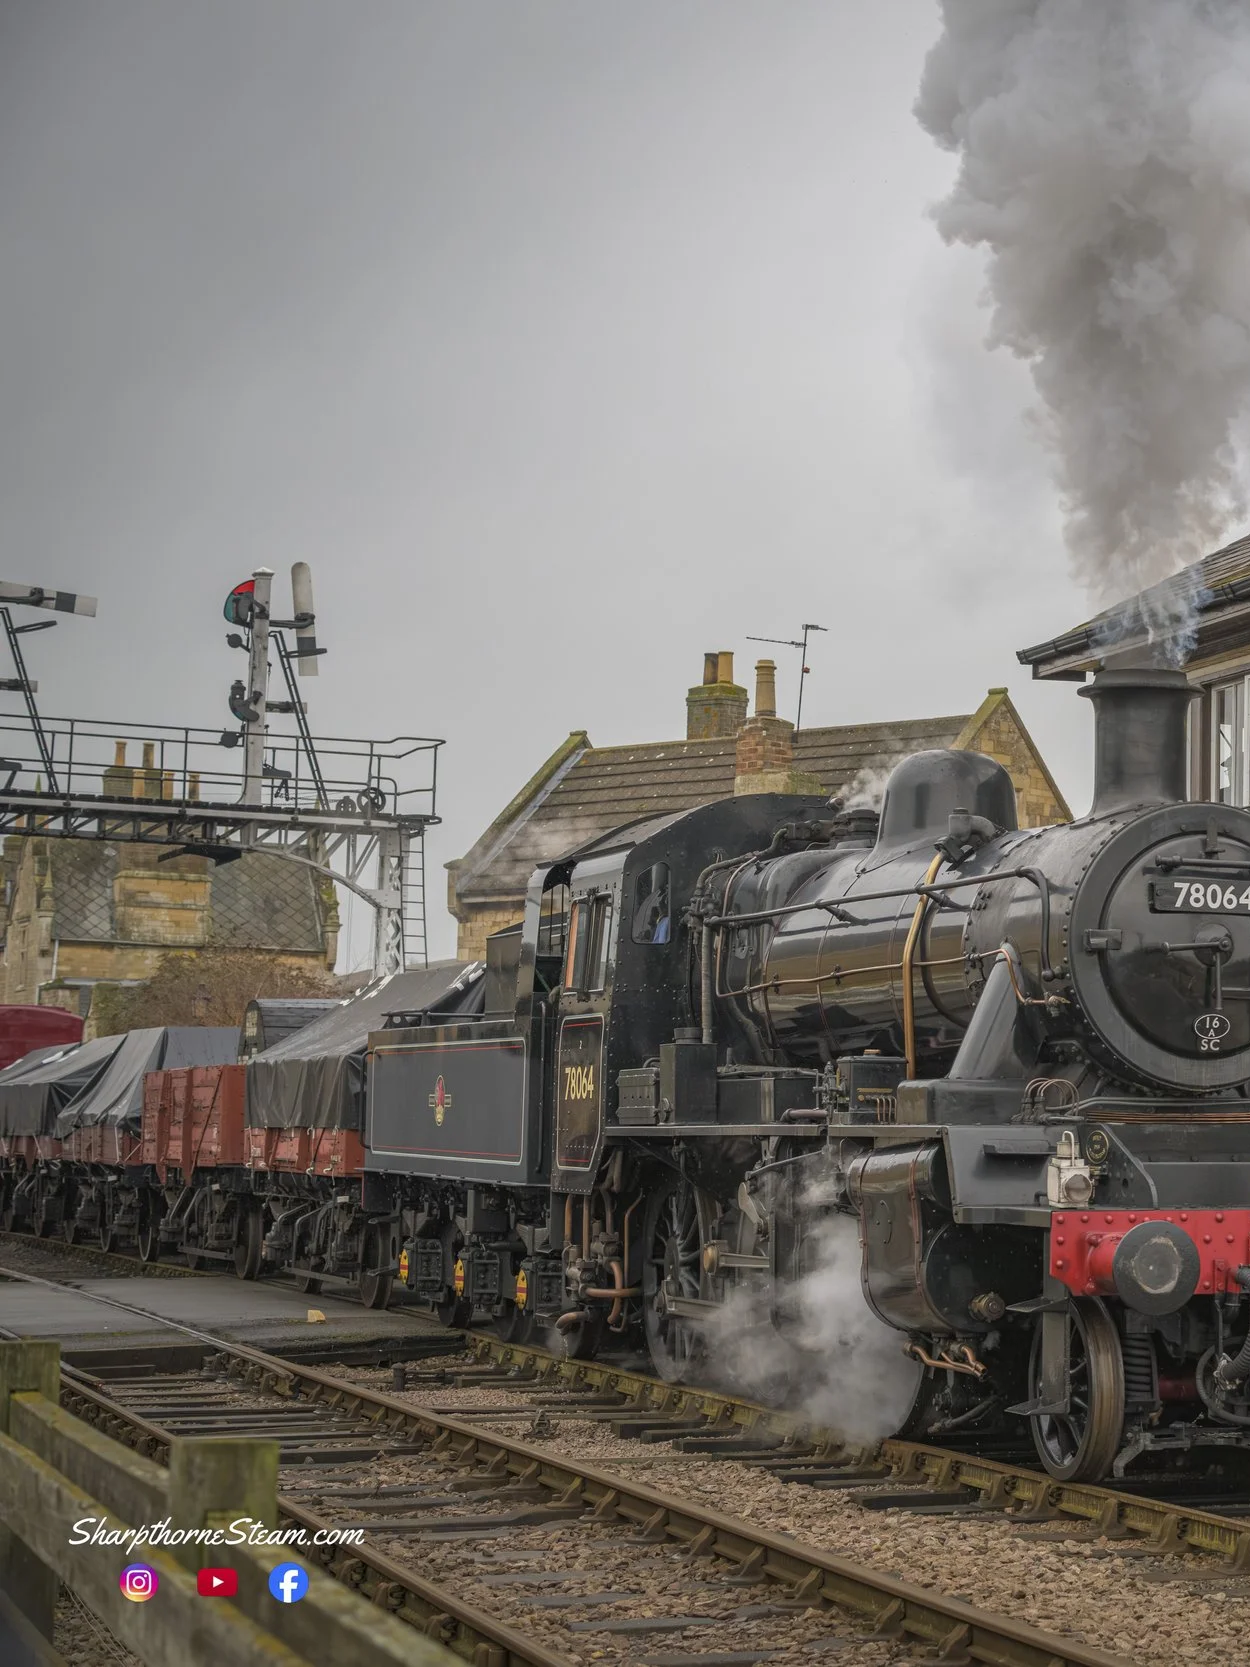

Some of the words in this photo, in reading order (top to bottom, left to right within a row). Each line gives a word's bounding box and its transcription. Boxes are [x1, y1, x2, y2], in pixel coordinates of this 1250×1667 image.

[1206, 1016, 1220, 1028] 16
[1208, 1029, 1215, 1037] A
[1200, 1039, 1220, 1050] SC
[565, 1065, 594, 1100] 78064
